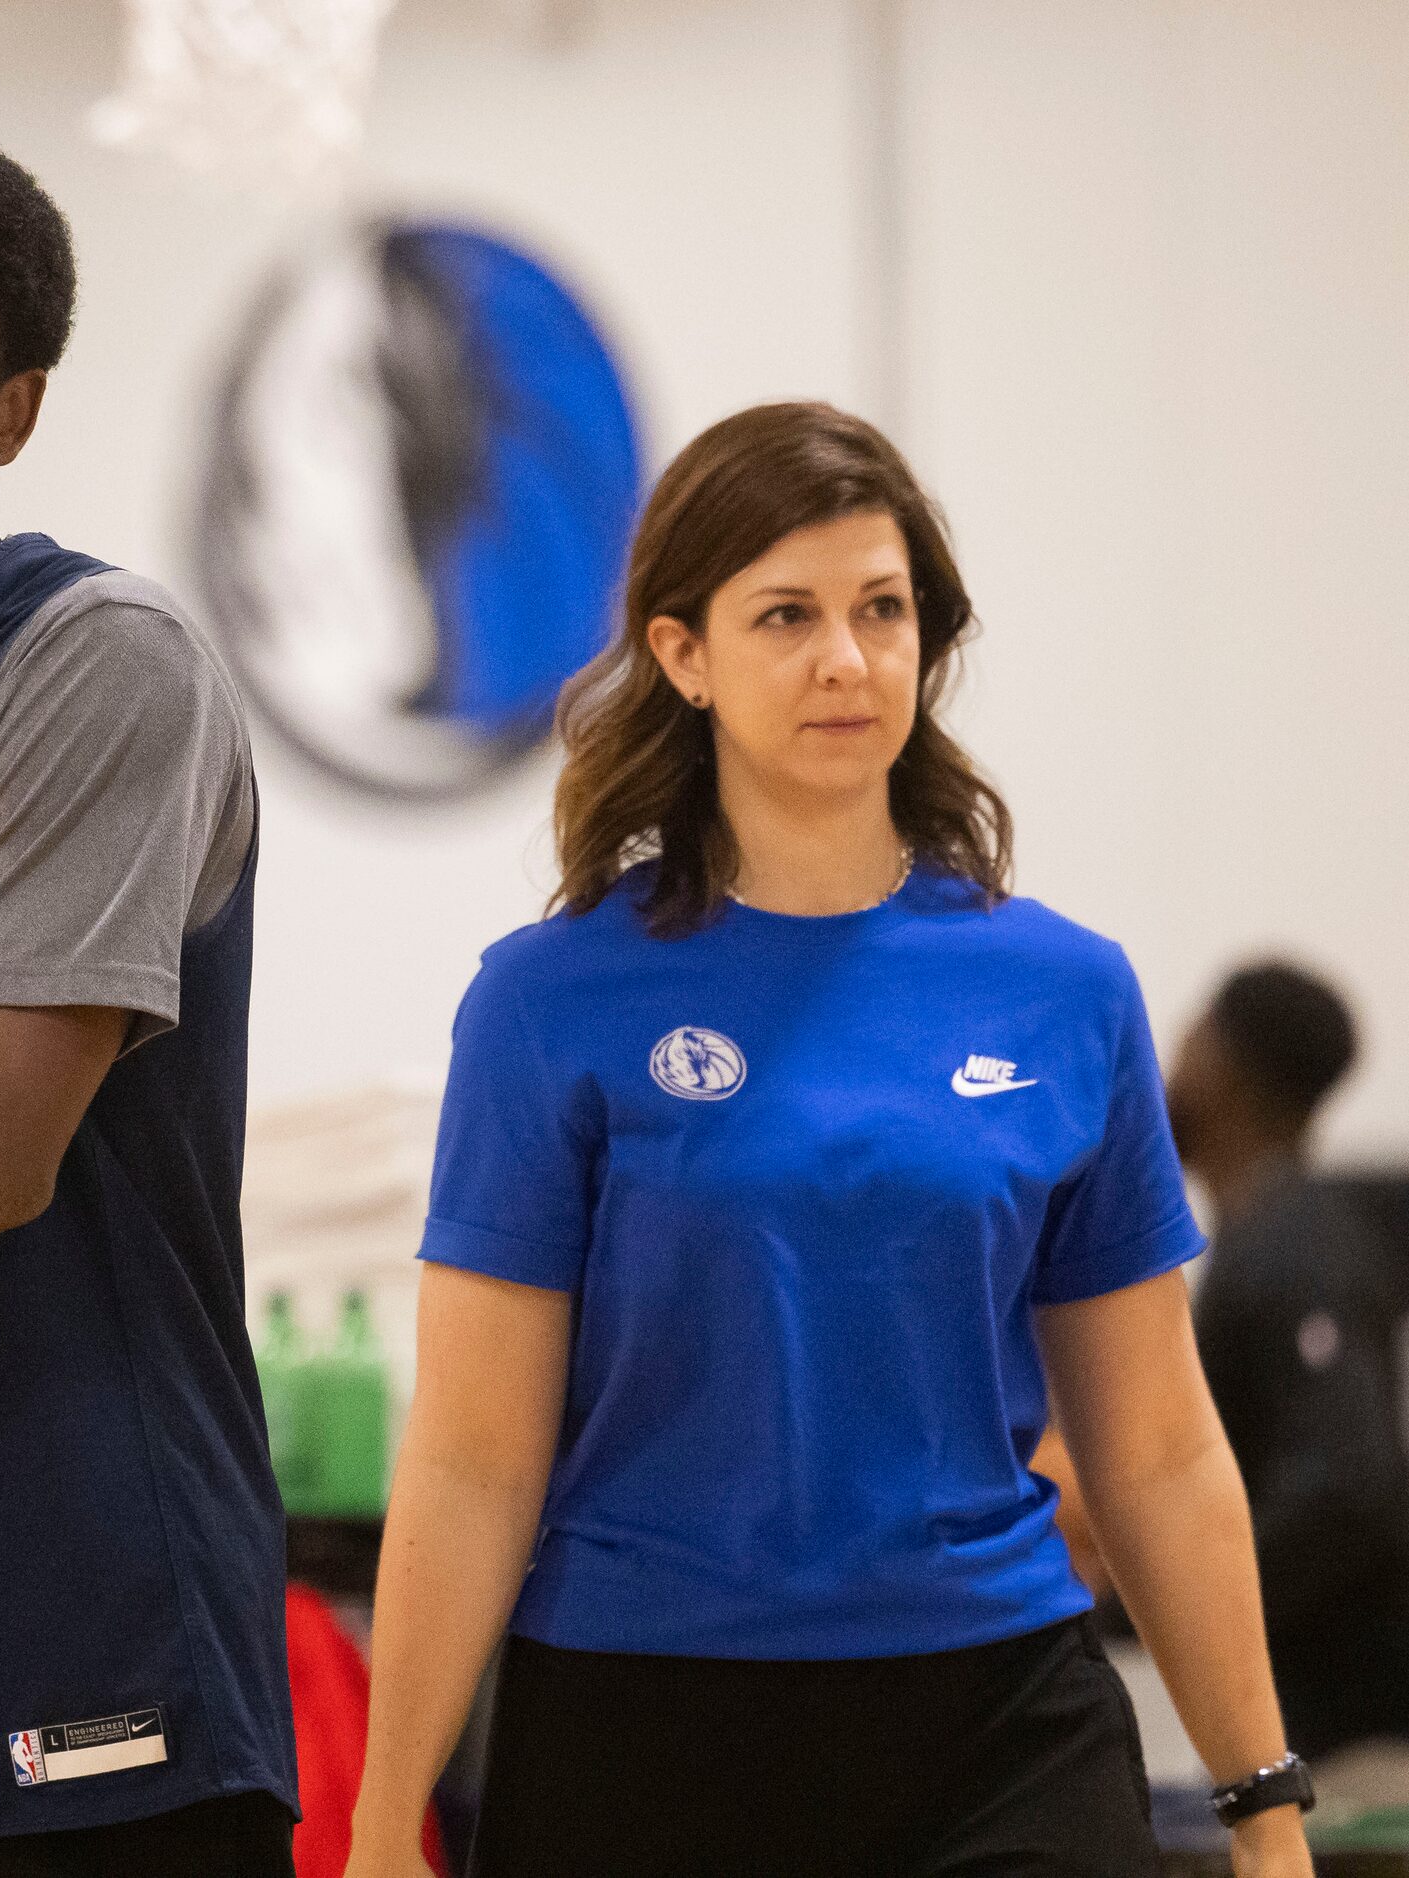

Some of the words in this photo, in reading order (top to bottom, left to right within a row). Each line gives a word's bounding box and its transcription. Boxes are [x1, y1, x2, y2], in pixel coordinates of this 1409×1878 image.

[963, 1053, 1018, 1084] NIKE
[68, 1721, 124, 1736] ENGINEERED
[51, 1735, 59, 1746] L
